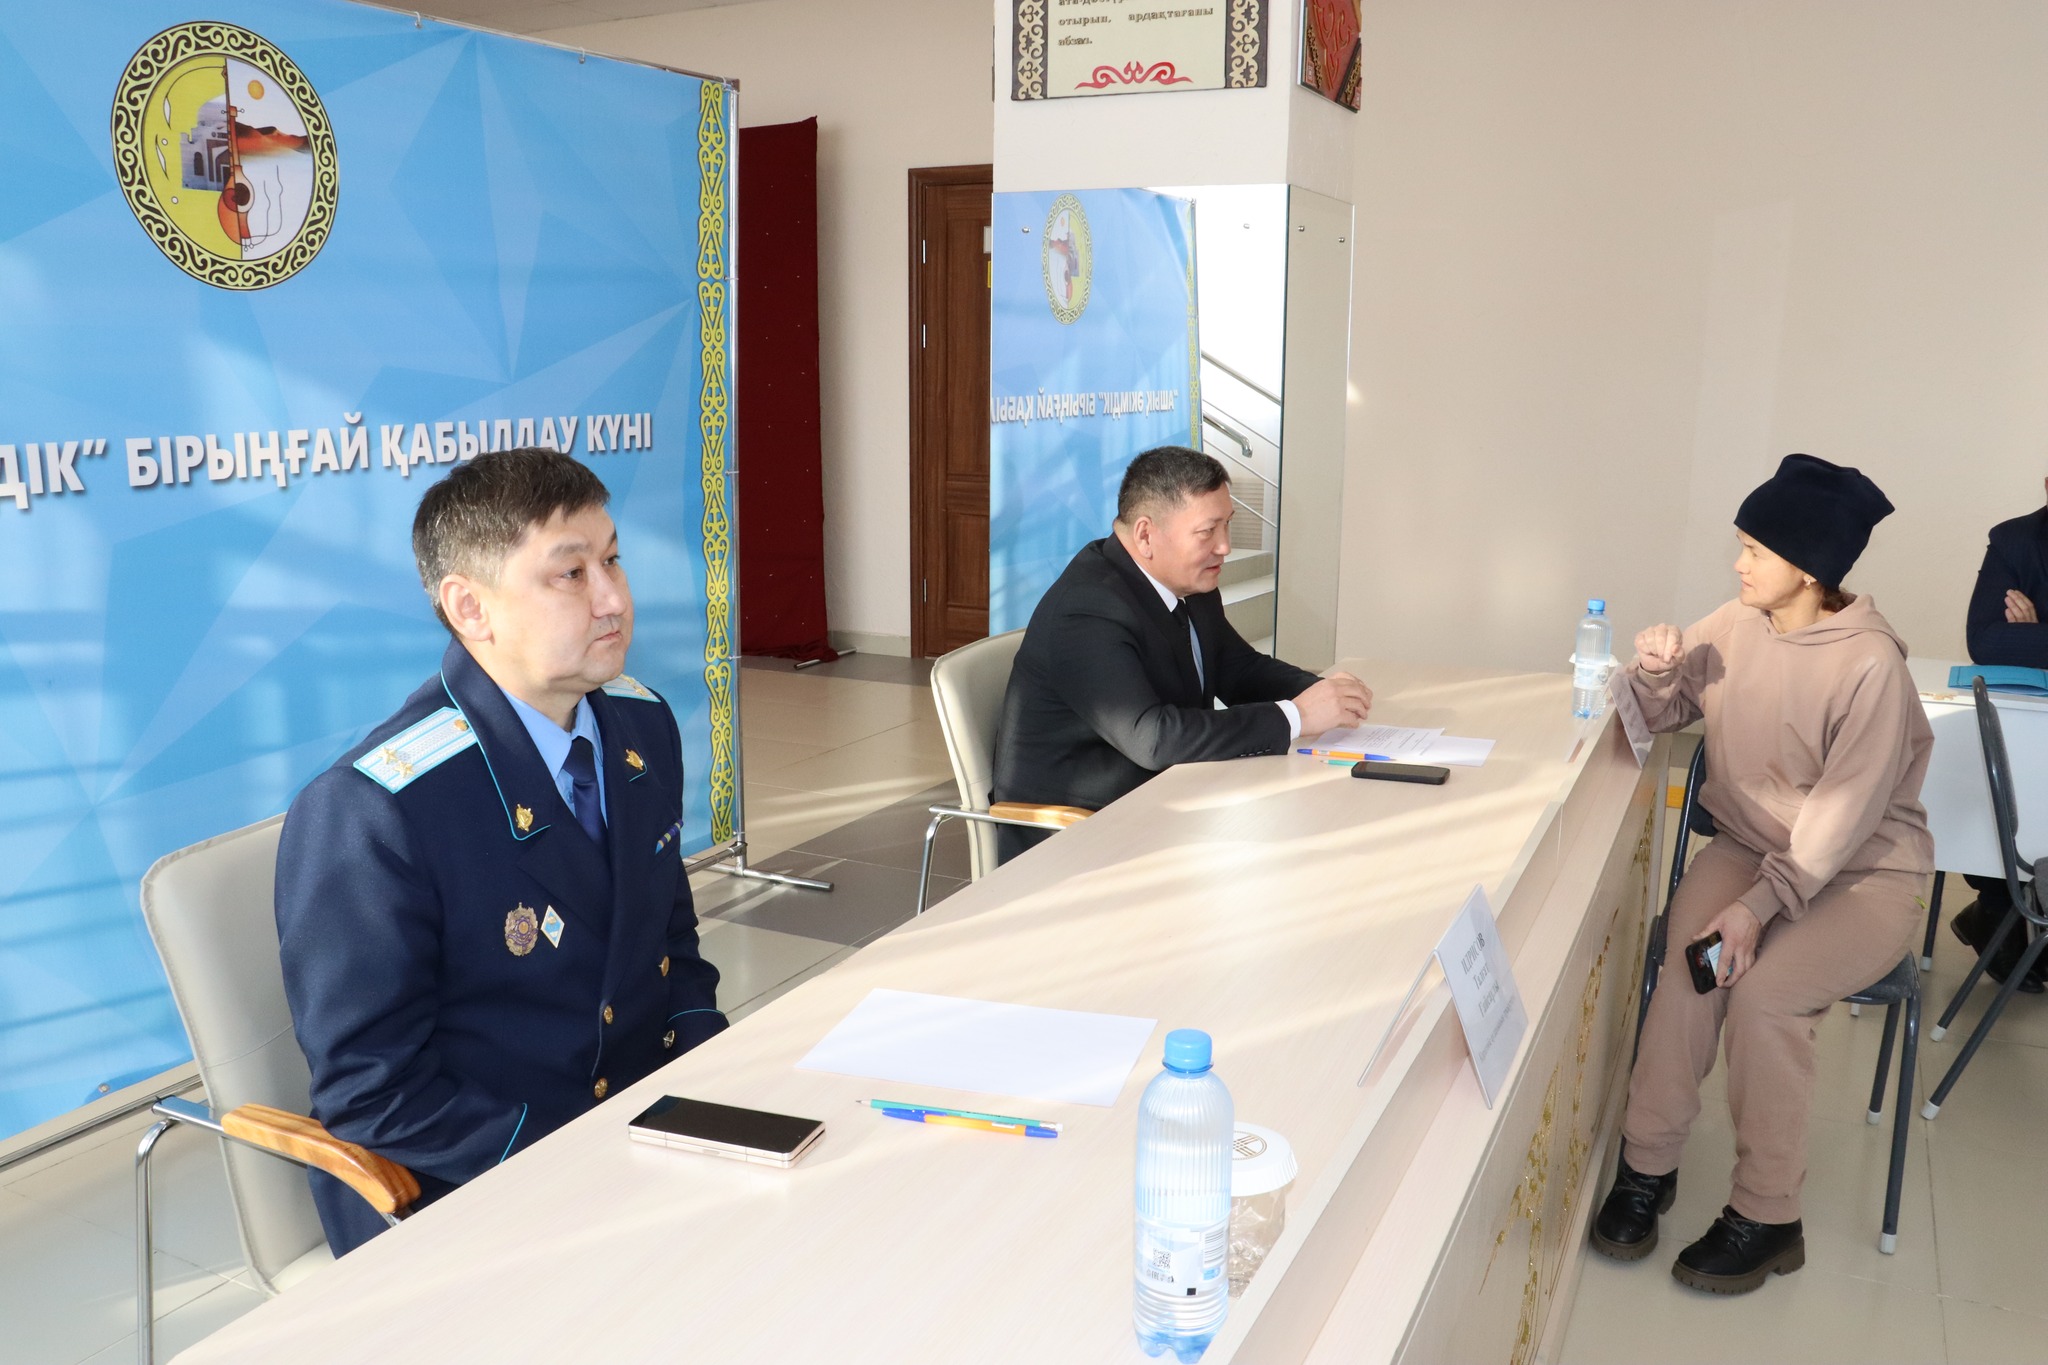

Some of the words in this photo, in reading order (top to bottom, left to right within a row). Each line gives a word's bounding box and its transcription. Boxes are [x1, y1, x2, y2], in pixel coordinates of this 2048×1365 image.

[1058, 15, 1112, 27] отырып,
[125, 411, 369, 488] БІРЫҢҒАЙ
[380, 415, 578, 477] ҚАБЫЛДАУ
[586, 412, 651, 452] КҮНІ
